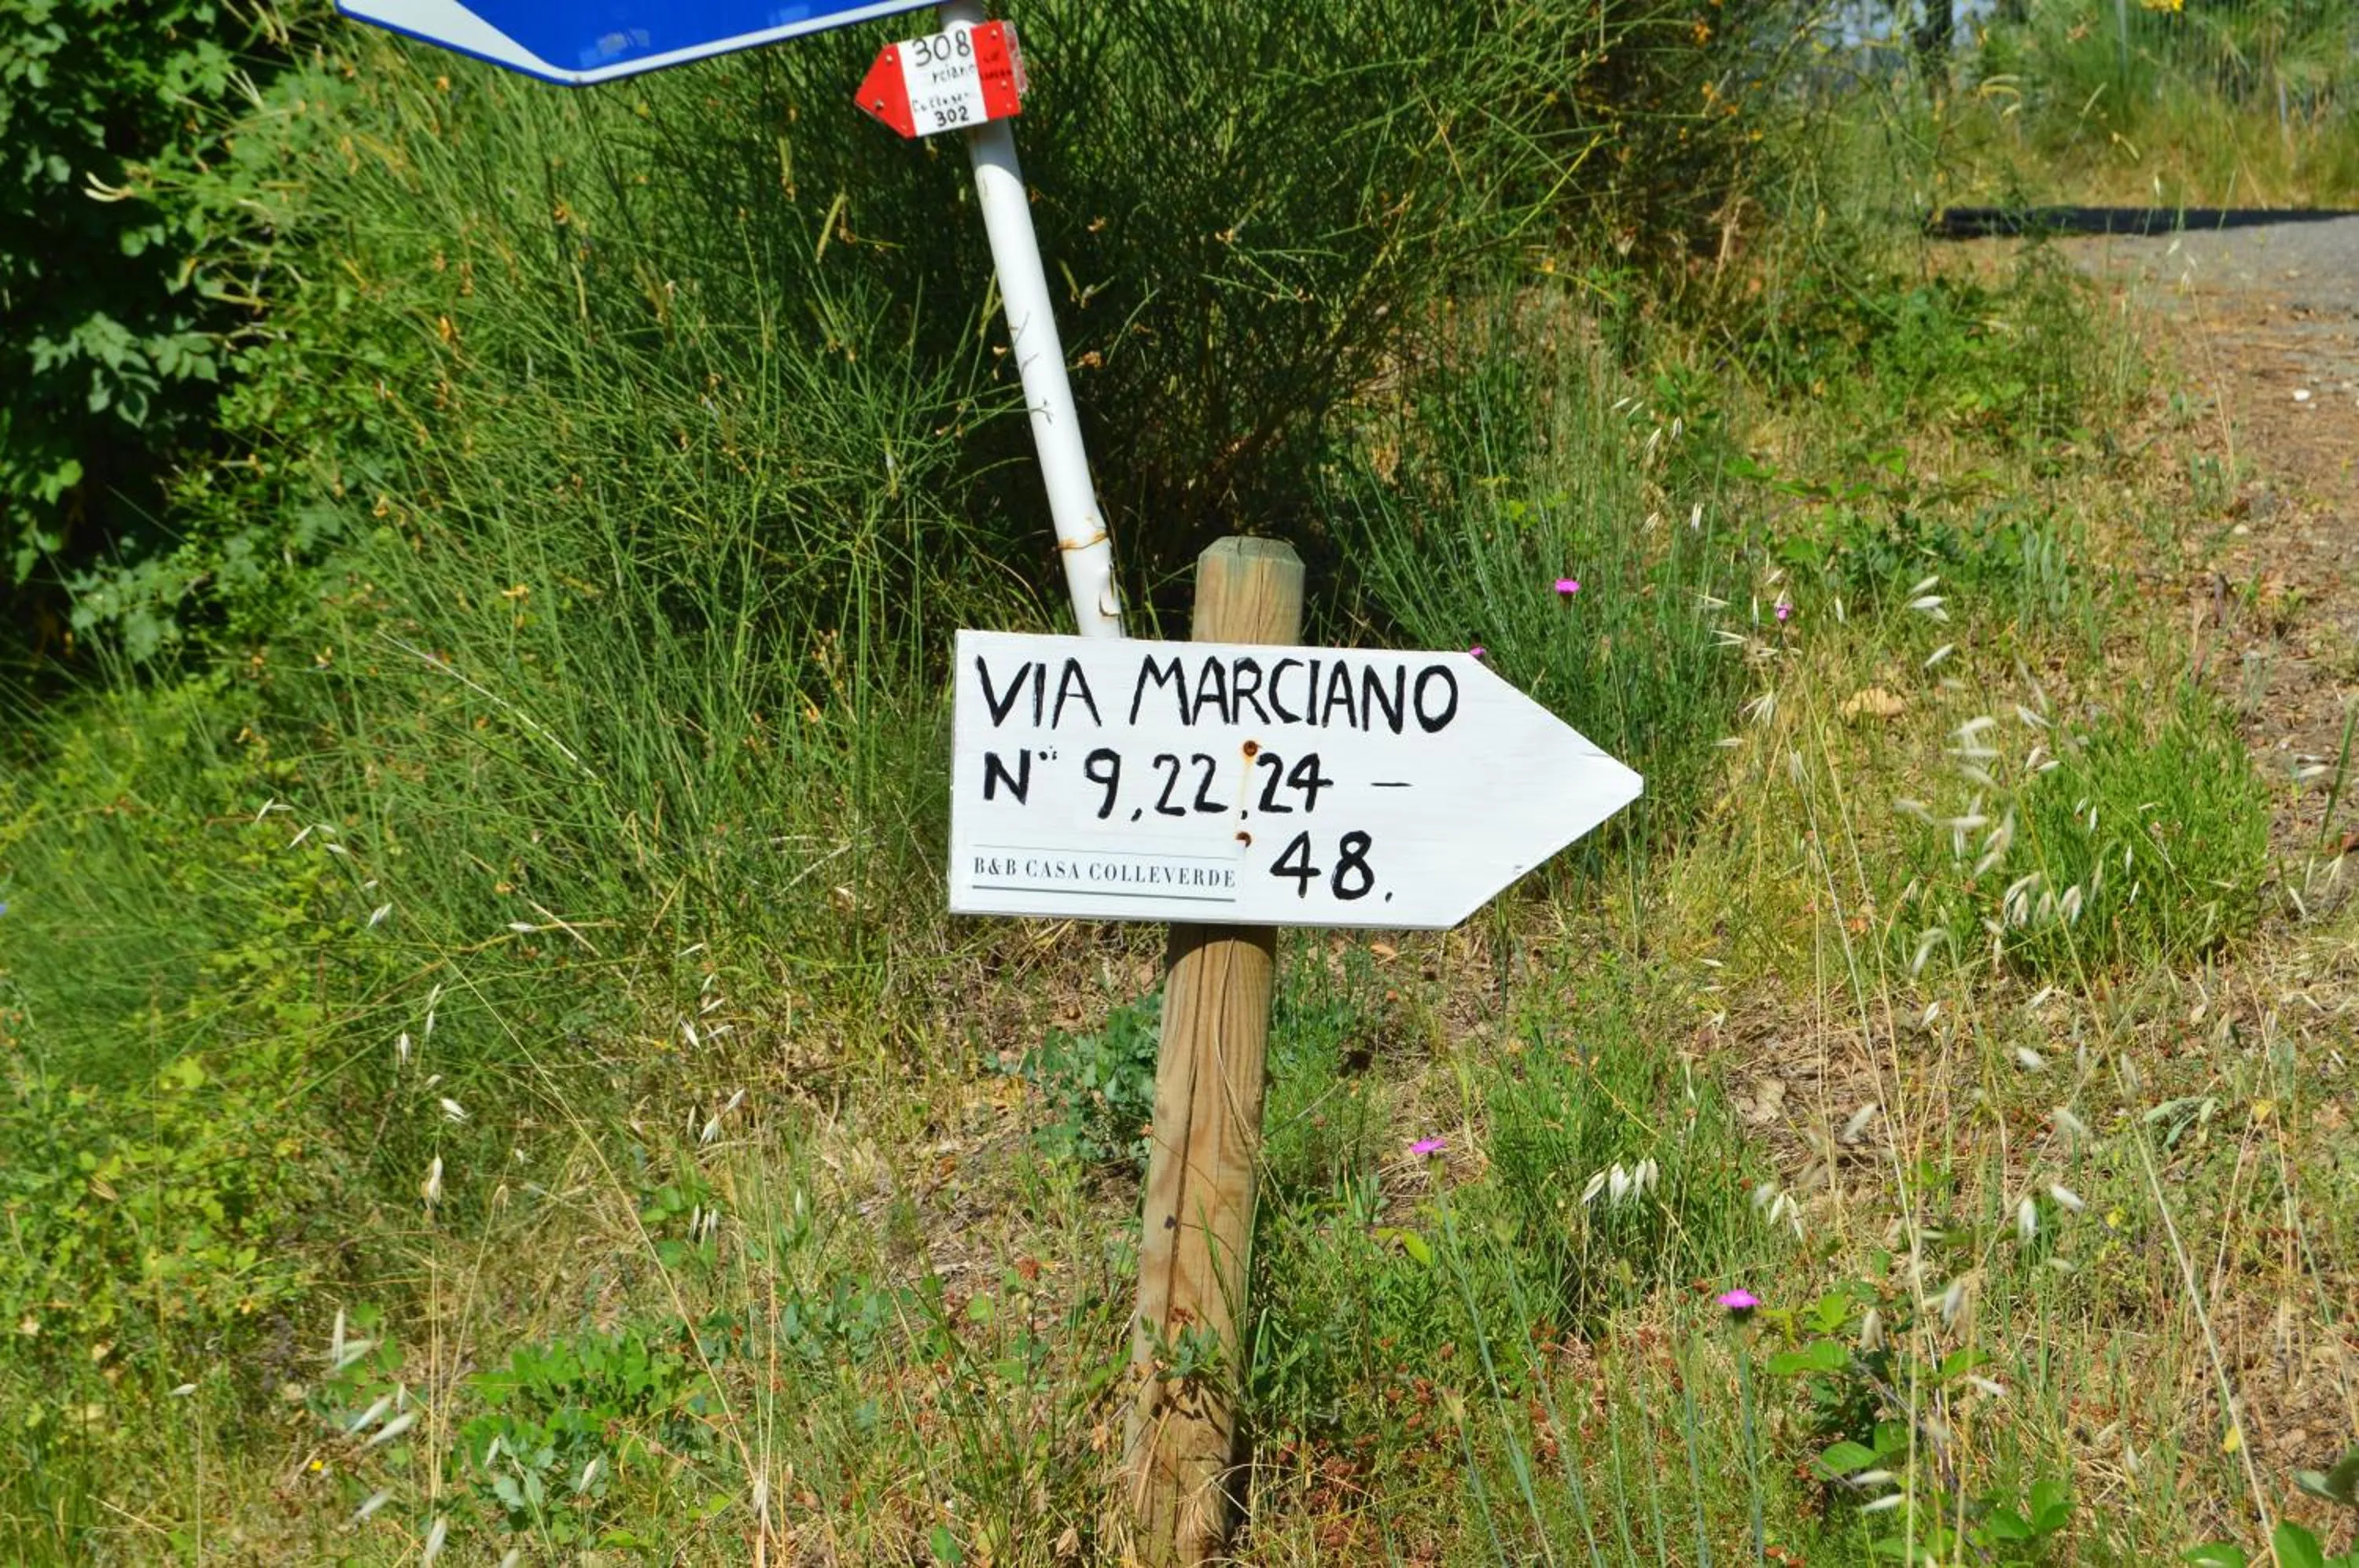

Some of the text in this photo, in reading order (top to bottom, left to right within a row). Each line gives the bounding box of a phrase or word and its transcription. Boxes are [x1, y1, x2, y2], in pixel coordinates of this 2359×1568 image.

[912, 29, 970, 68] 308
[934, 105, 970, 127] 302
[976, 653, 1459, 735] VIA MARCIANO
[974, 857, 1235, 888] B&B CASA COLLEVERDE
